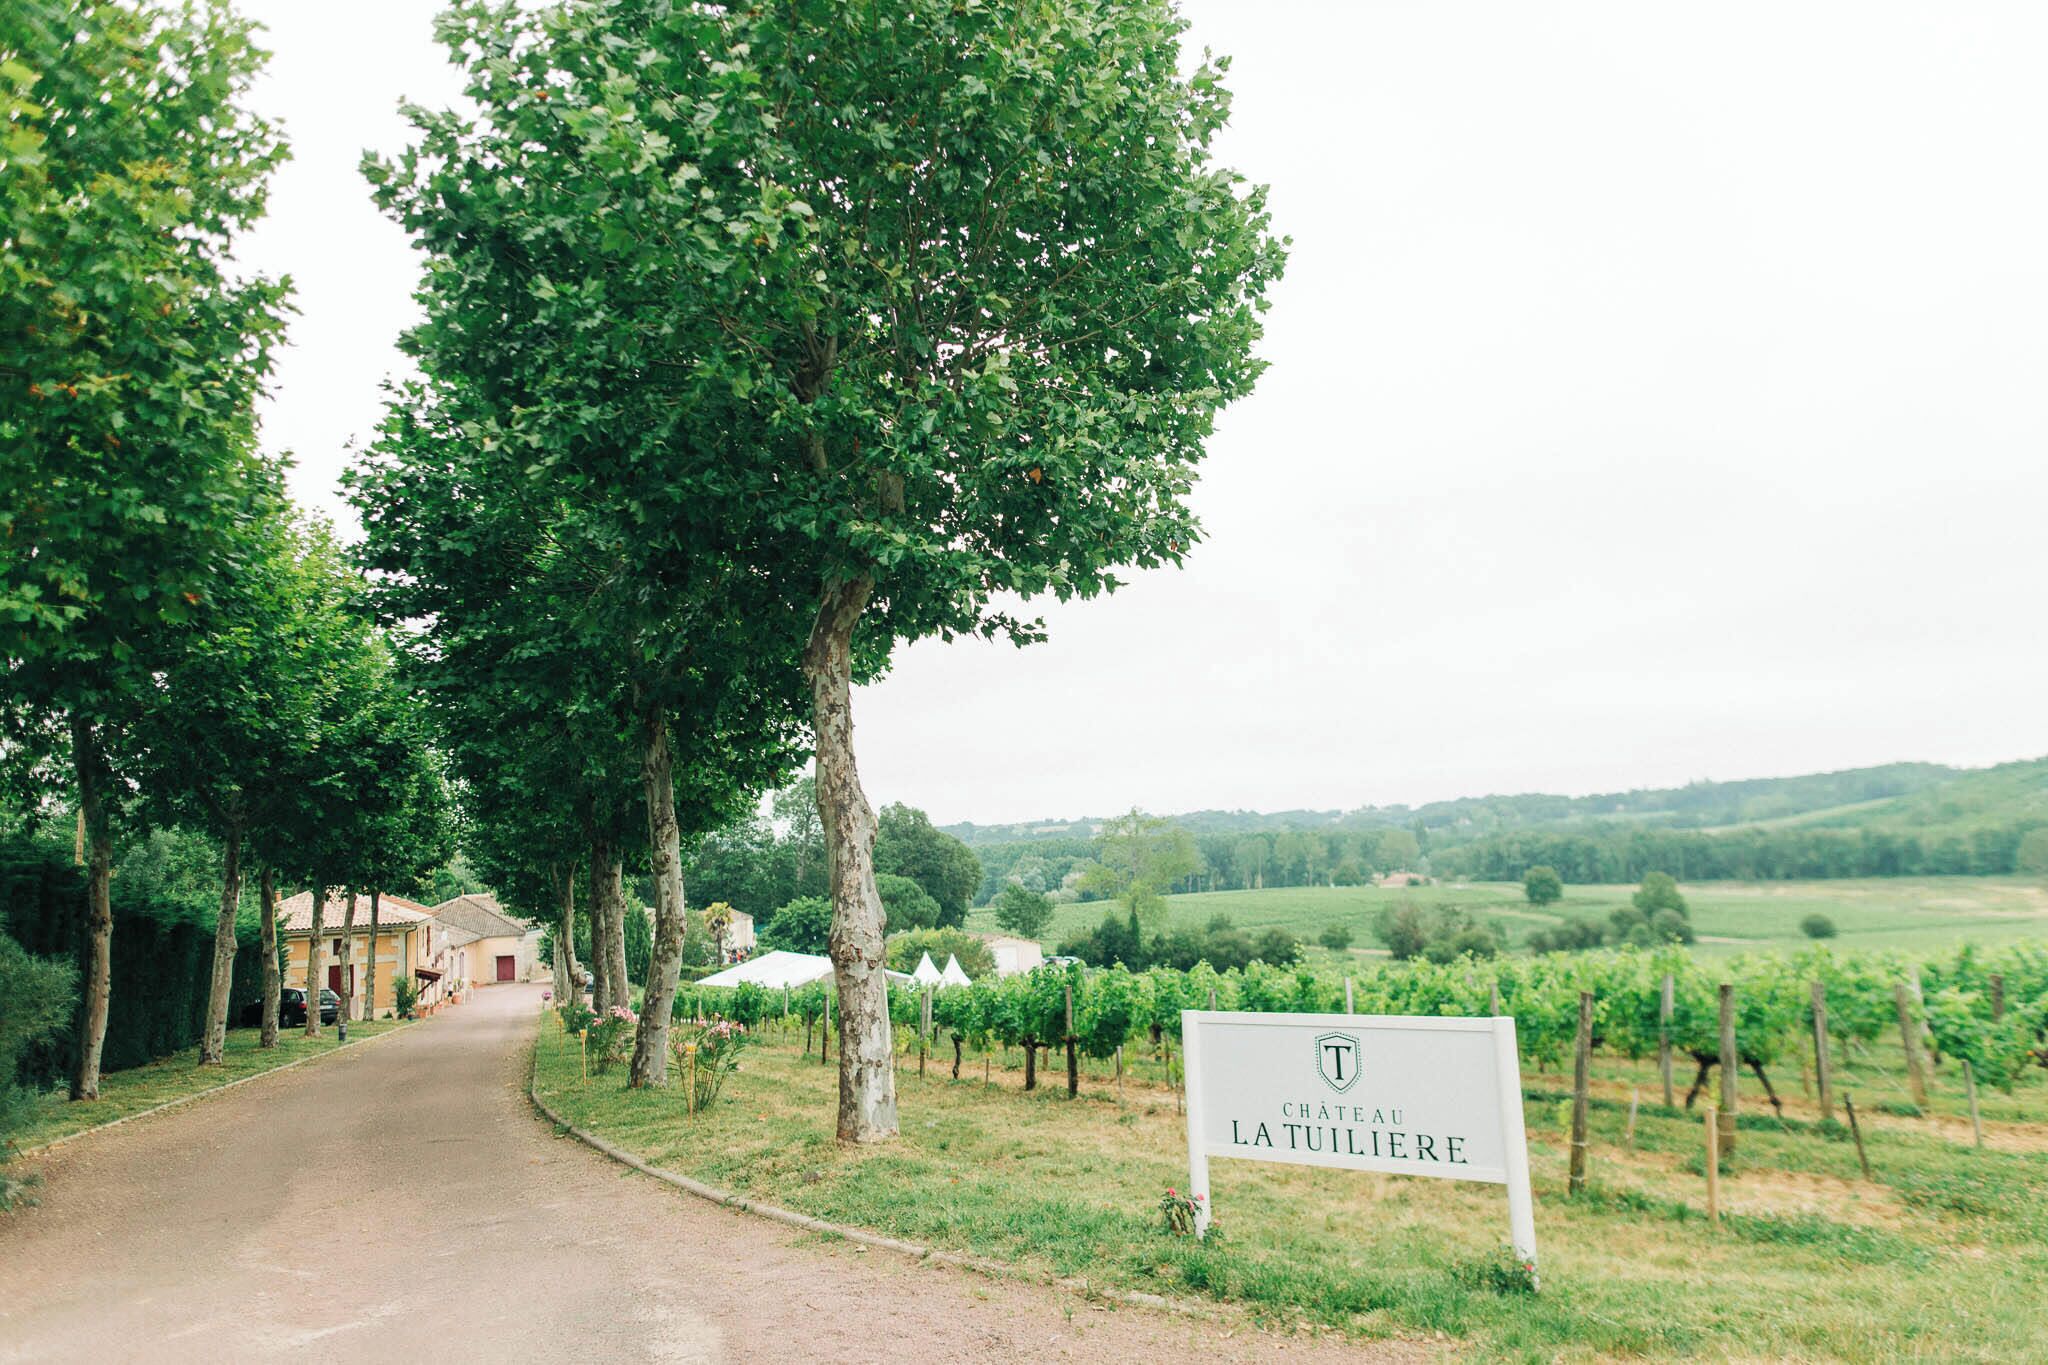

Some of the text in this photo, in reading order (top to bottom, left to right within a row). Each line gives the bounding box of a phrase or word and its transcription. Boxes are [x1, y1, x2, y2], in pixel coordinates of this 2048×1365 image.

[1324, 1045, 1351, 1081] T
[1283, 1101, 1403, 1125] CHÂTEAU
[1232, 1120, 1468, 1164] LA TUILIERE
